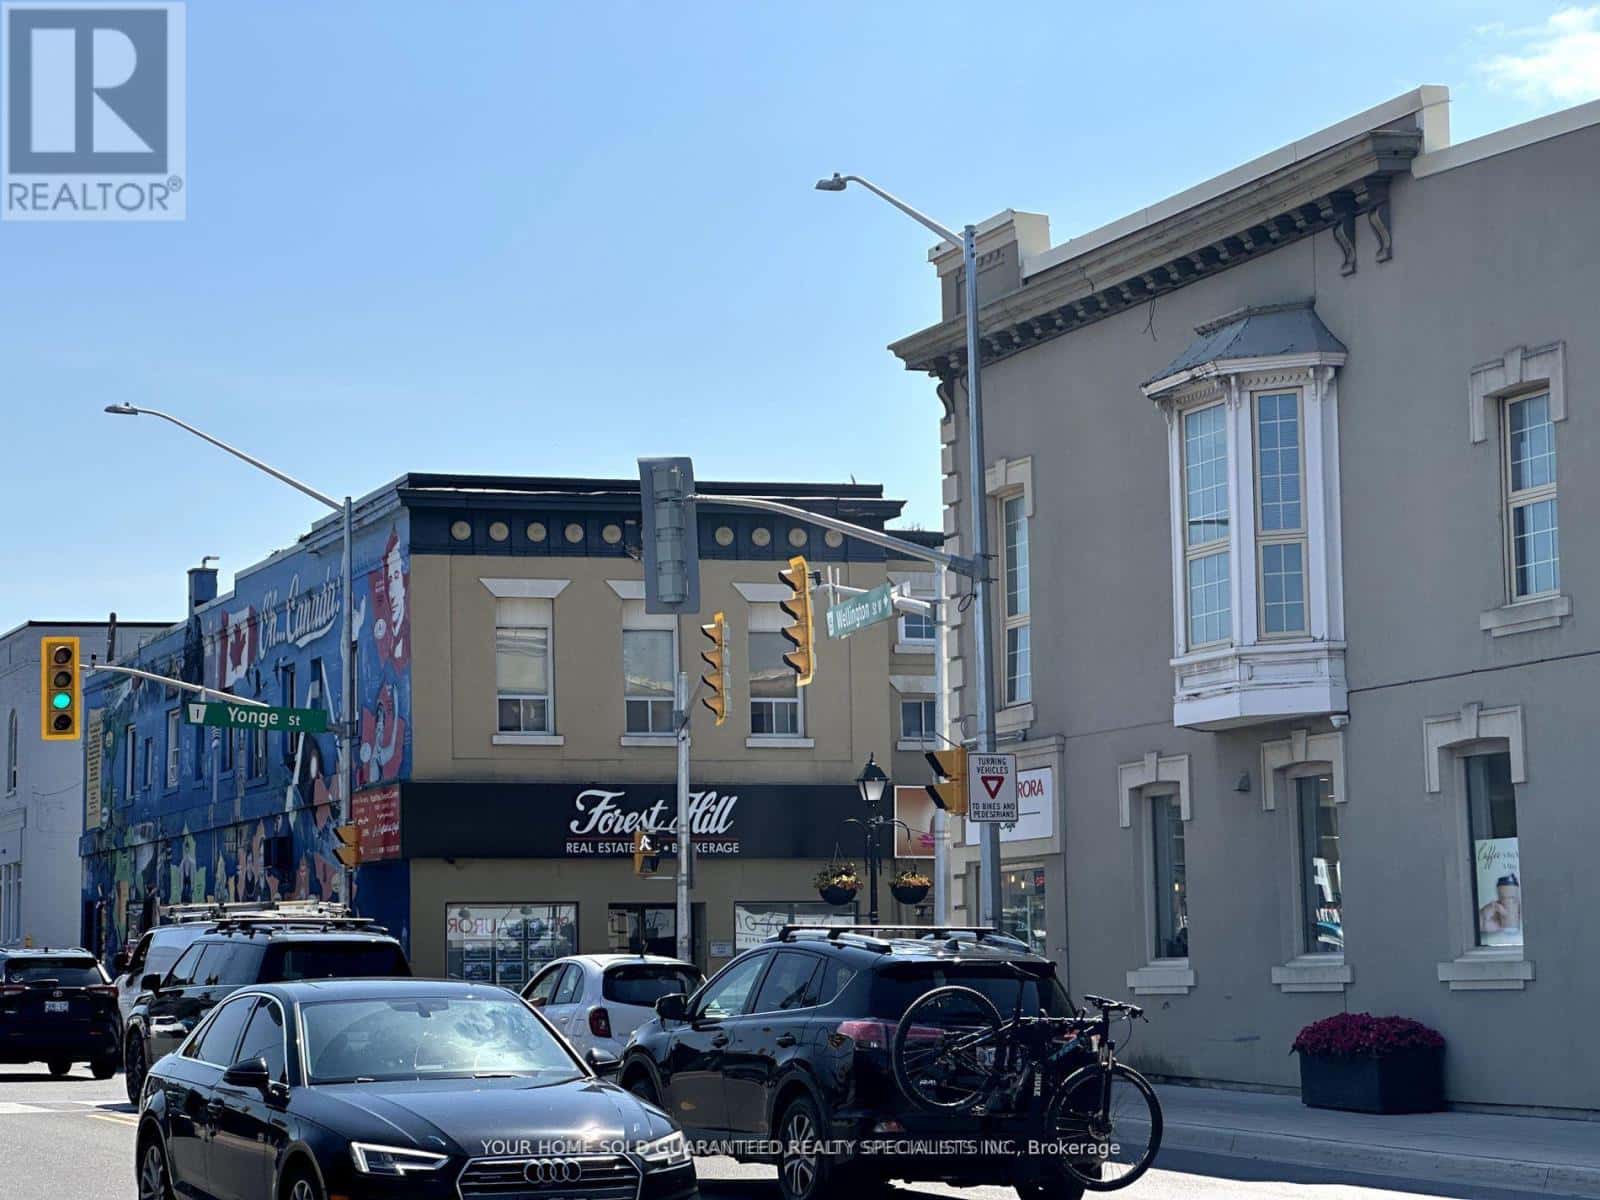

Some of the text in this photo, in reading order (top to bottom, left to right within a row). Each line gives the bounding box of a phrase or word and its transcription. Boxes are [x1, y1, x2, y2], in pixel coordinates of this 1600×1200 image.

[228, 706, 279, 728] Yonge
[288, 715, 301, 727] St
[978, 757, 1007, 766] TURNING
[976, 766, 1009, 775] VEHICLES
[1017, 778, 1045, 799] RORA
[972, 802, 1015, 810] TO BIKES AND
[569, 789, 738, 834] Forest Hill
[973, 810, 1015, 819] PEDESTRIANS
[566, 842, 594, 854] REAL
[599, 842, 635, 854] ESTATE
[672, 842, 740, 854] BKERAGE
